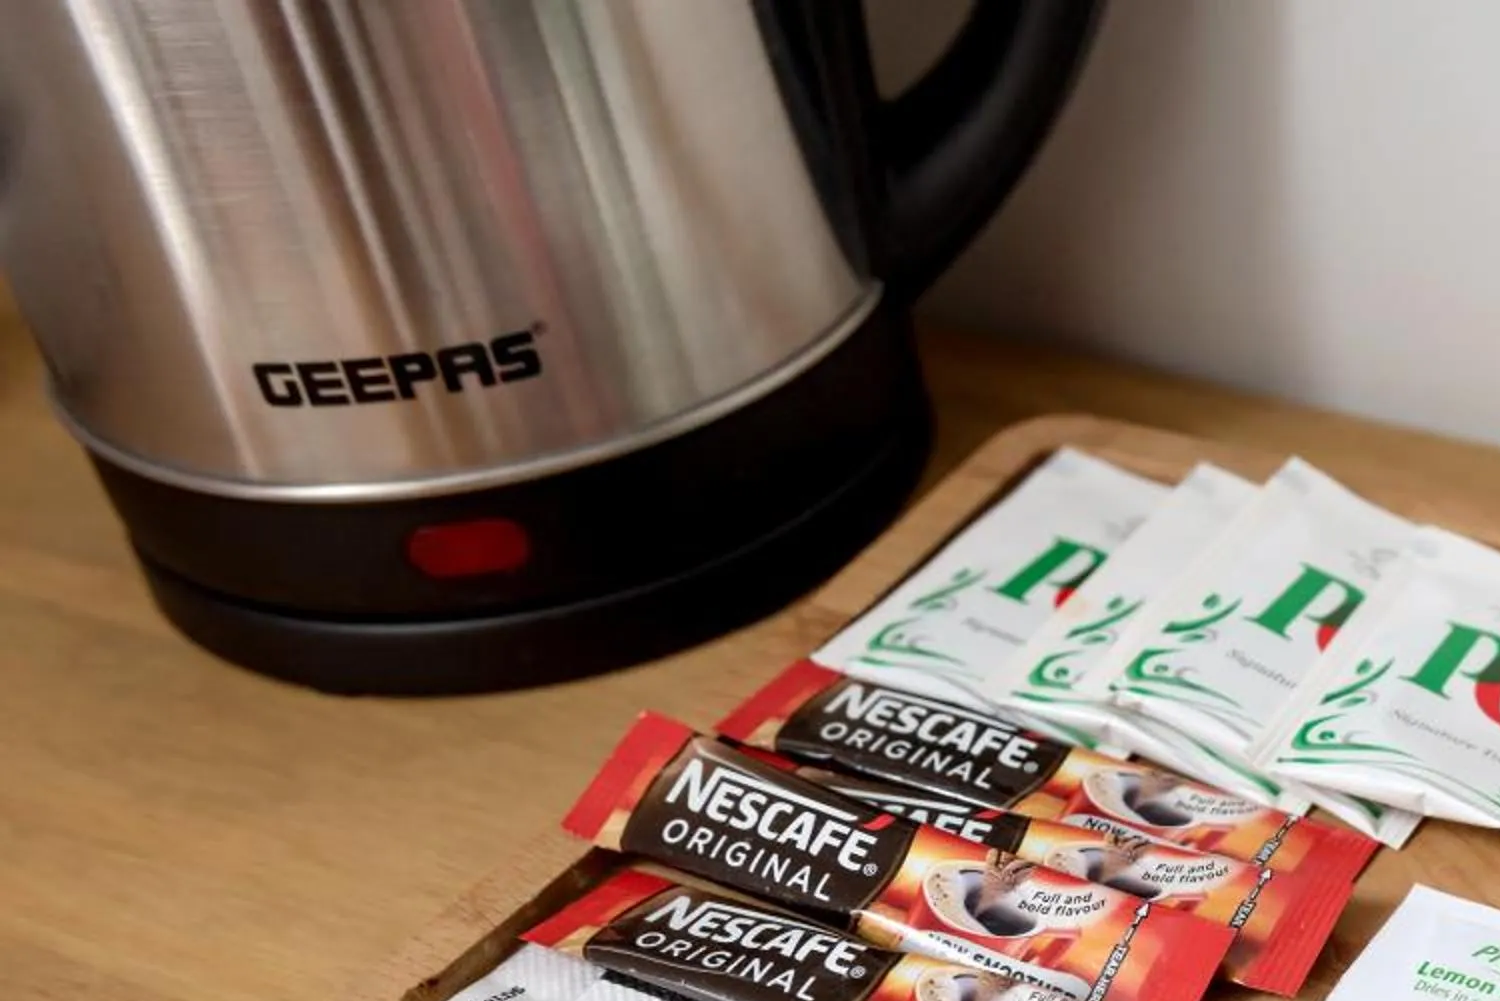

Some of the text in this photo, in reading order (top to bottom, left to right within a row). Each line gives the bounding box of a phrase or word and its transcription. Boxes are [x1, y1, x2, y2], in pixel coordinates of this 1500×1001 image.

[253, 331, 542, 407] GEEPAS
[986, 534, 1109, 608] P
[1244, 562, 1367, 652] P
[820, 722, 993, 789] ORIGINAL
[661, 818, 832, 902] ORIGINAL
[1017, 899, 1107, 918] bold flavour
[1031, 891, 1094, 905] Full and
[635, 931, 817, 1001] ORIGINAL
[1413, 979, 1450, 999] Dries
[1416, 961, 1496, 995] Lemon
